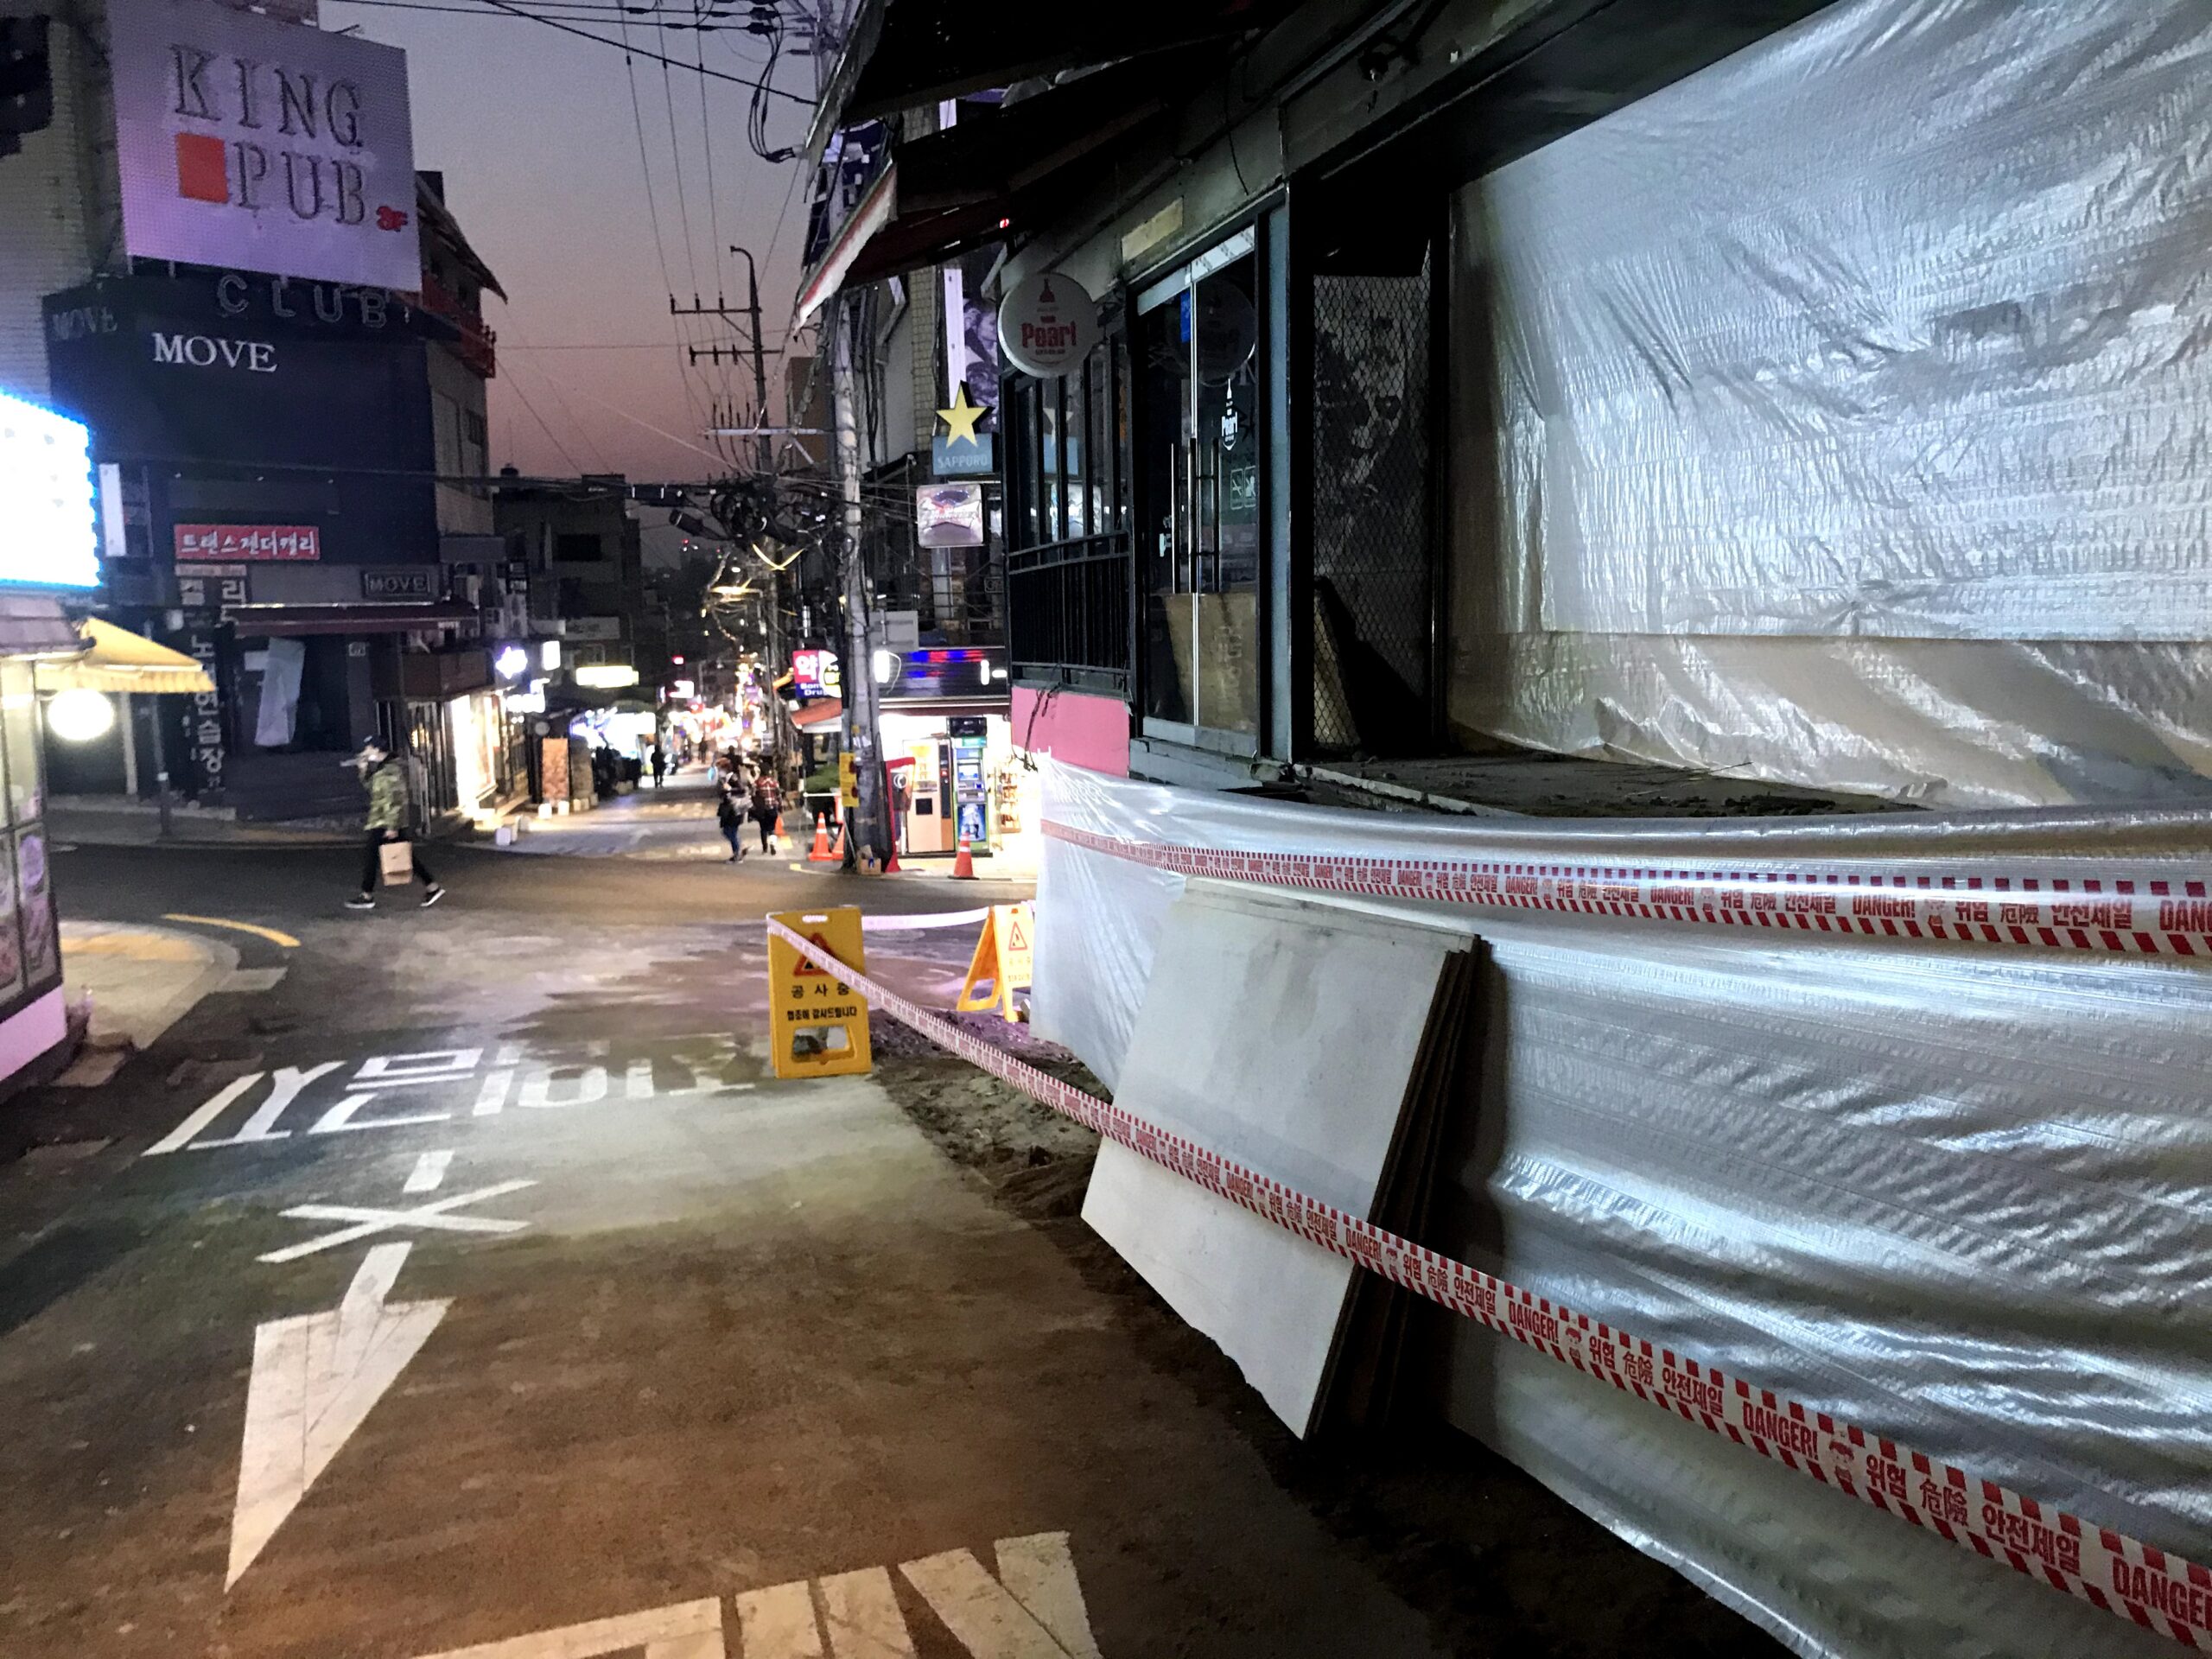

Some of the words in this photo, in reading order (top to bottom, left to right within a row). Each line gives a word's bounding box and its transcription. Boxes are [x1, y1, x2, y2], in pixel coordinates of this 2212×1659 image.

[168, 43, 365, 149] KING
[232, 141, 367, 226] PUB
[216, 273, 389, 329] CLUB
[153, 332, 277, 373] MOVE
[1021, 321, 1077, 348] Pearl
[937, 454, 988, 469] SAPPORO
[370, 575, 425, 594] MOVE
[1506, 875, 1538, 895] DANGER!
[1557, 879, 1573, 898] 위험
[1650, 885, 1694, 906] DANGER!
[1720, 888, 1744, 909] 위험
[1853, 895, 1916, 918] DANGER!
[2051, 899, 2133, 929] 안전제일
[1306, 1209, 1338, 1242] 안전제일
[1346, 1227, 1382, 1262] DANGER!
[1402, 1254, 1422, 1281] 위험
[1427, 1265, 1449, 1294] 危險
[1453, 1276, 1496, 1316] 안전제일
[1509, 1300, 1560, 1344] DANGER!
[1589, 1334, 1615, 1370] 위험
[1623, 1351, 1654, 1387] 危險
[1662, 1367, 1723, 1418] 안전제일
[1743, 1402, 1819, 1460] DANGER!
[1866, 1453, 1908, 1501] 위험
[1920, 1478, 1969, 1527] 危險
[1982, 1504, 2081, 1576] 안전제일
